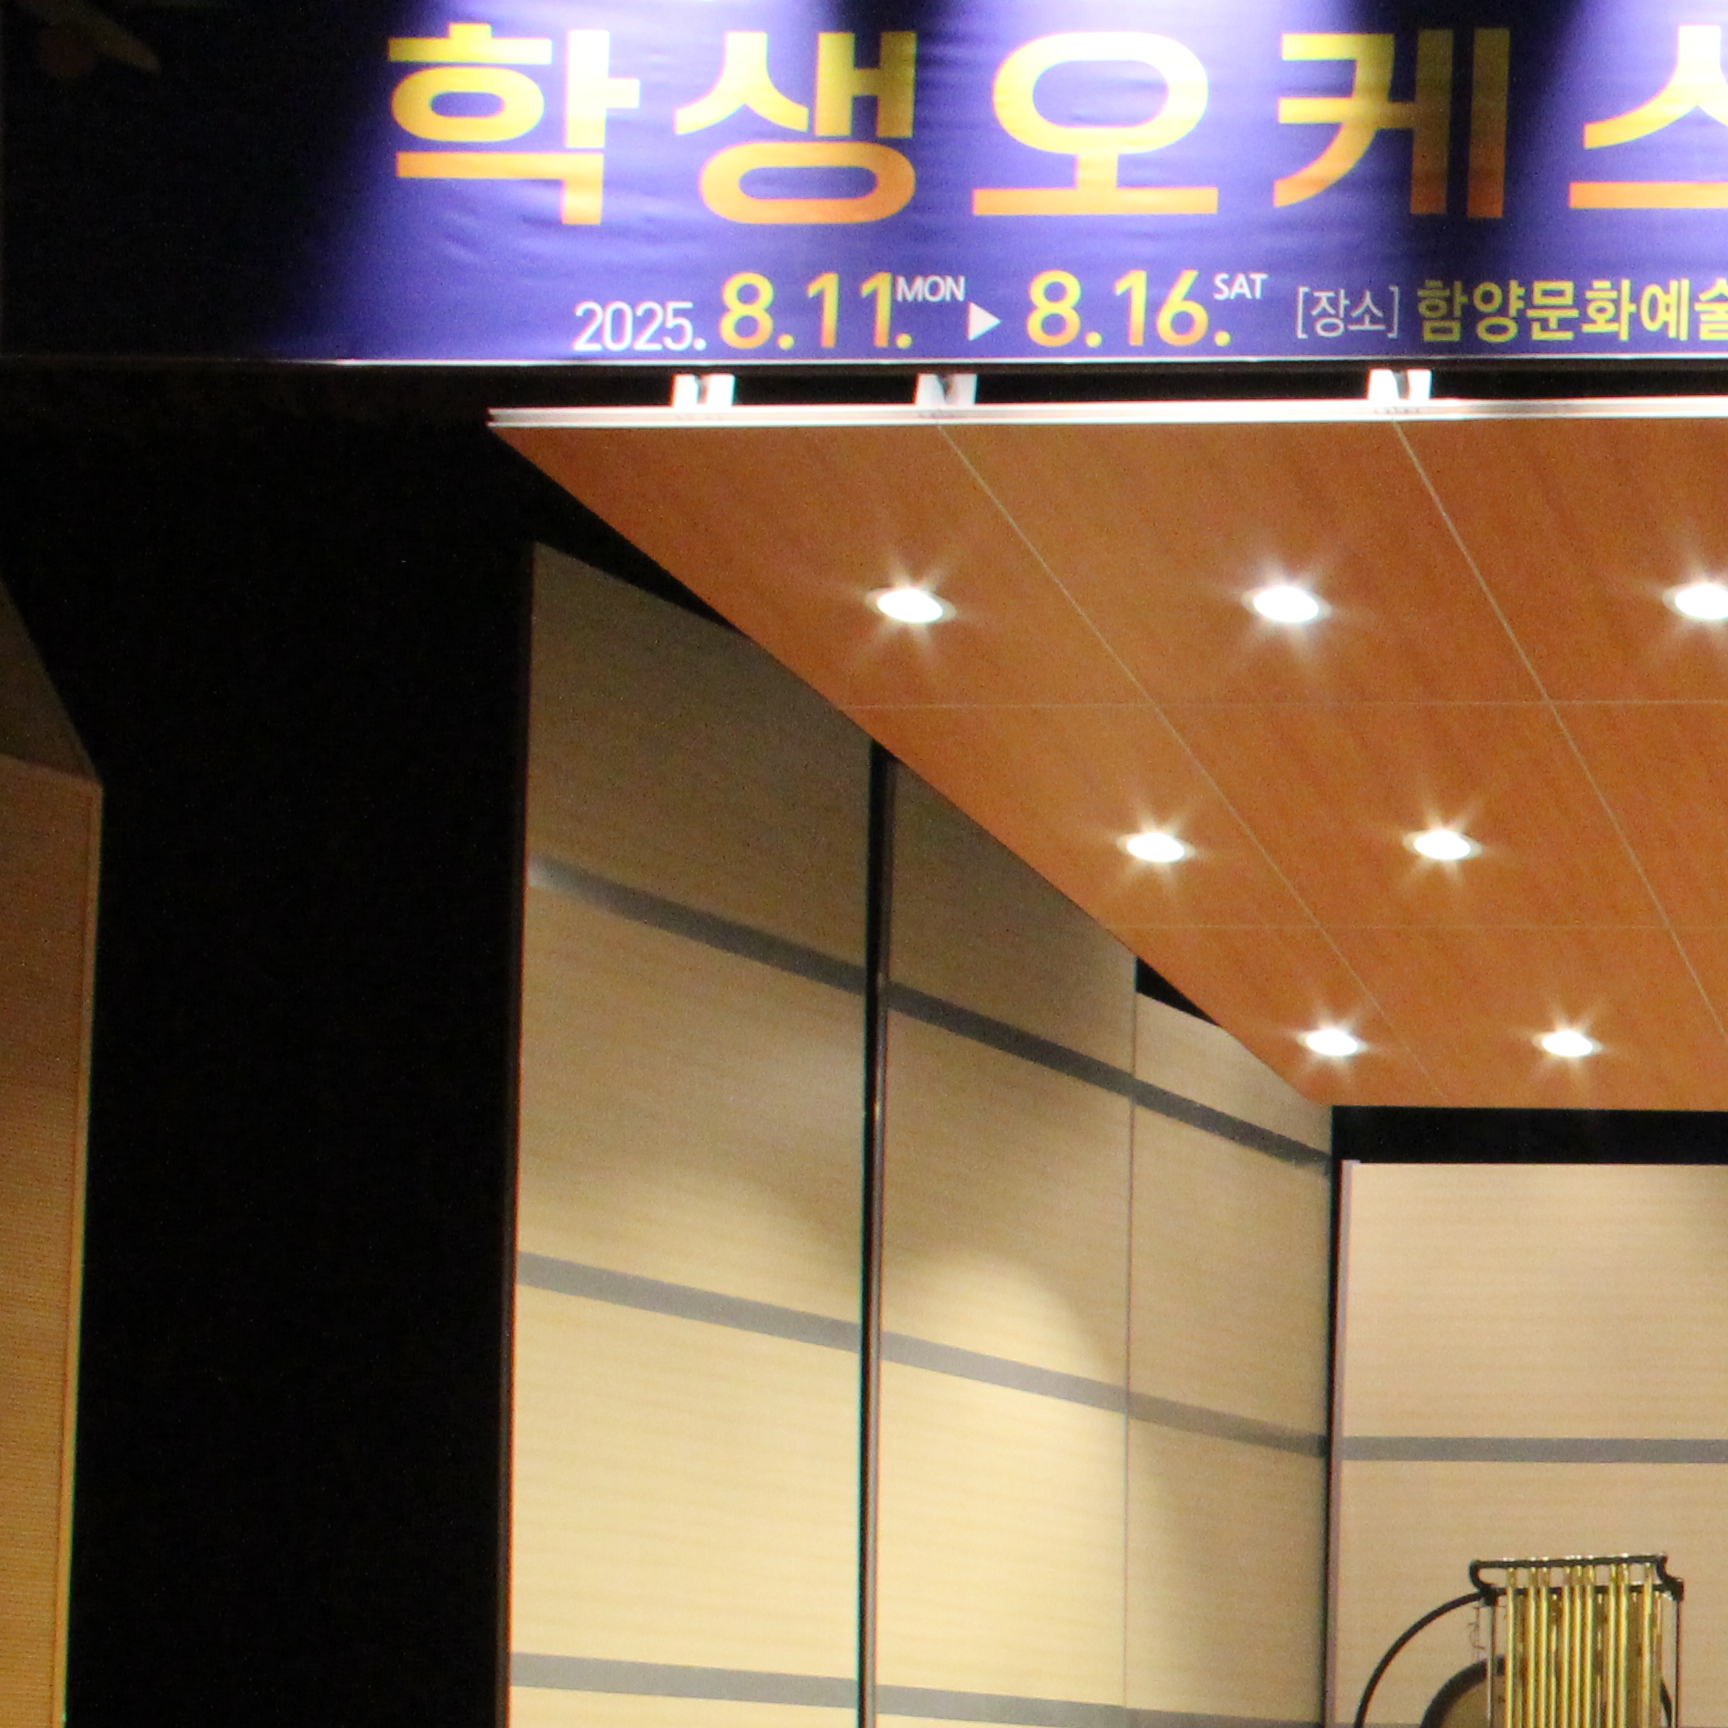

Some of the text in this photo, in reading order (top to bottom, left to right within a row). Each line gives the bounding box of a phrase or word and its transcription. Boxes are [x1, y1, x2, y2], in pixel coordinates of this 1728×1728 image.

[574, 301, 707, 352] 2025.
[896, 276, 966, 302] MON
[1213, 273, 1268, 300] SAT
[1296, 285, 1400, 339] [장소]
